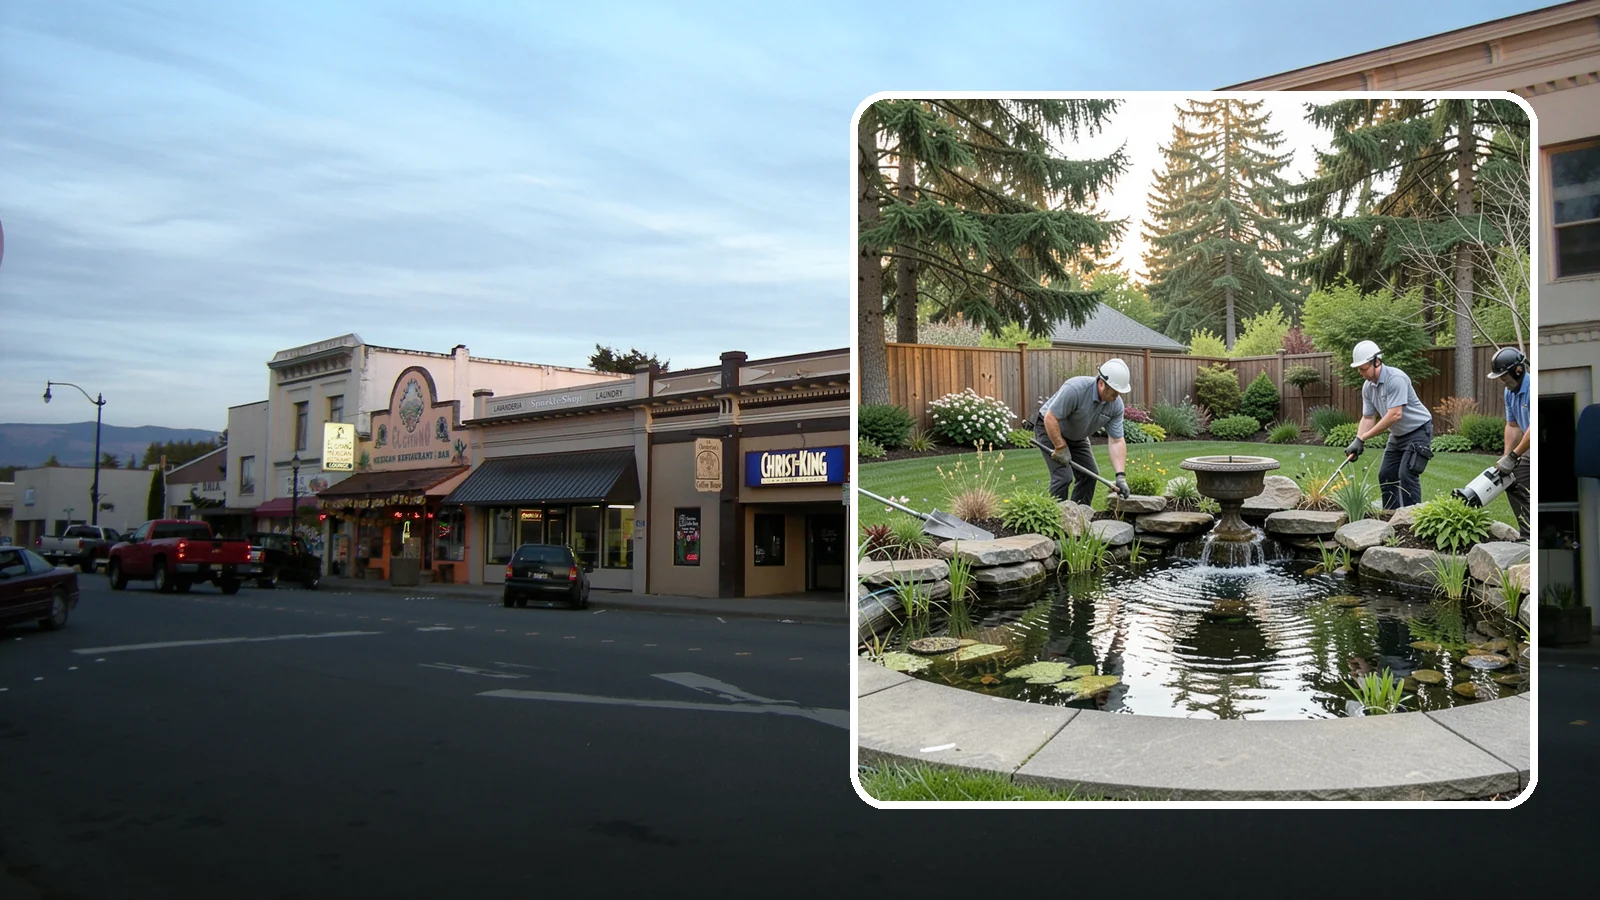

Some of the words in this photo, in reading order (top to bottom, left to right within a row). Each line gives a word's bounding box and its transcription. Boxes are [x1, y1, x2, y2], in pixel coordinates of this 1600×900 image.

[531, 398, 560, 409] Sparkle
[561, 394, 582, 405] Shop
[595, 389, 623, 400] LAUNDRY
[493, 402, 522, 412] LAVANDERIA
[373, 455, 396, 464] MEXICAN
[397, 452, 433, 462] RESTAURANT
[438, 450, 450, 458] BAR
[761, 452, 797, 478] CHRIST
[799, 450, 827, 476] KING
